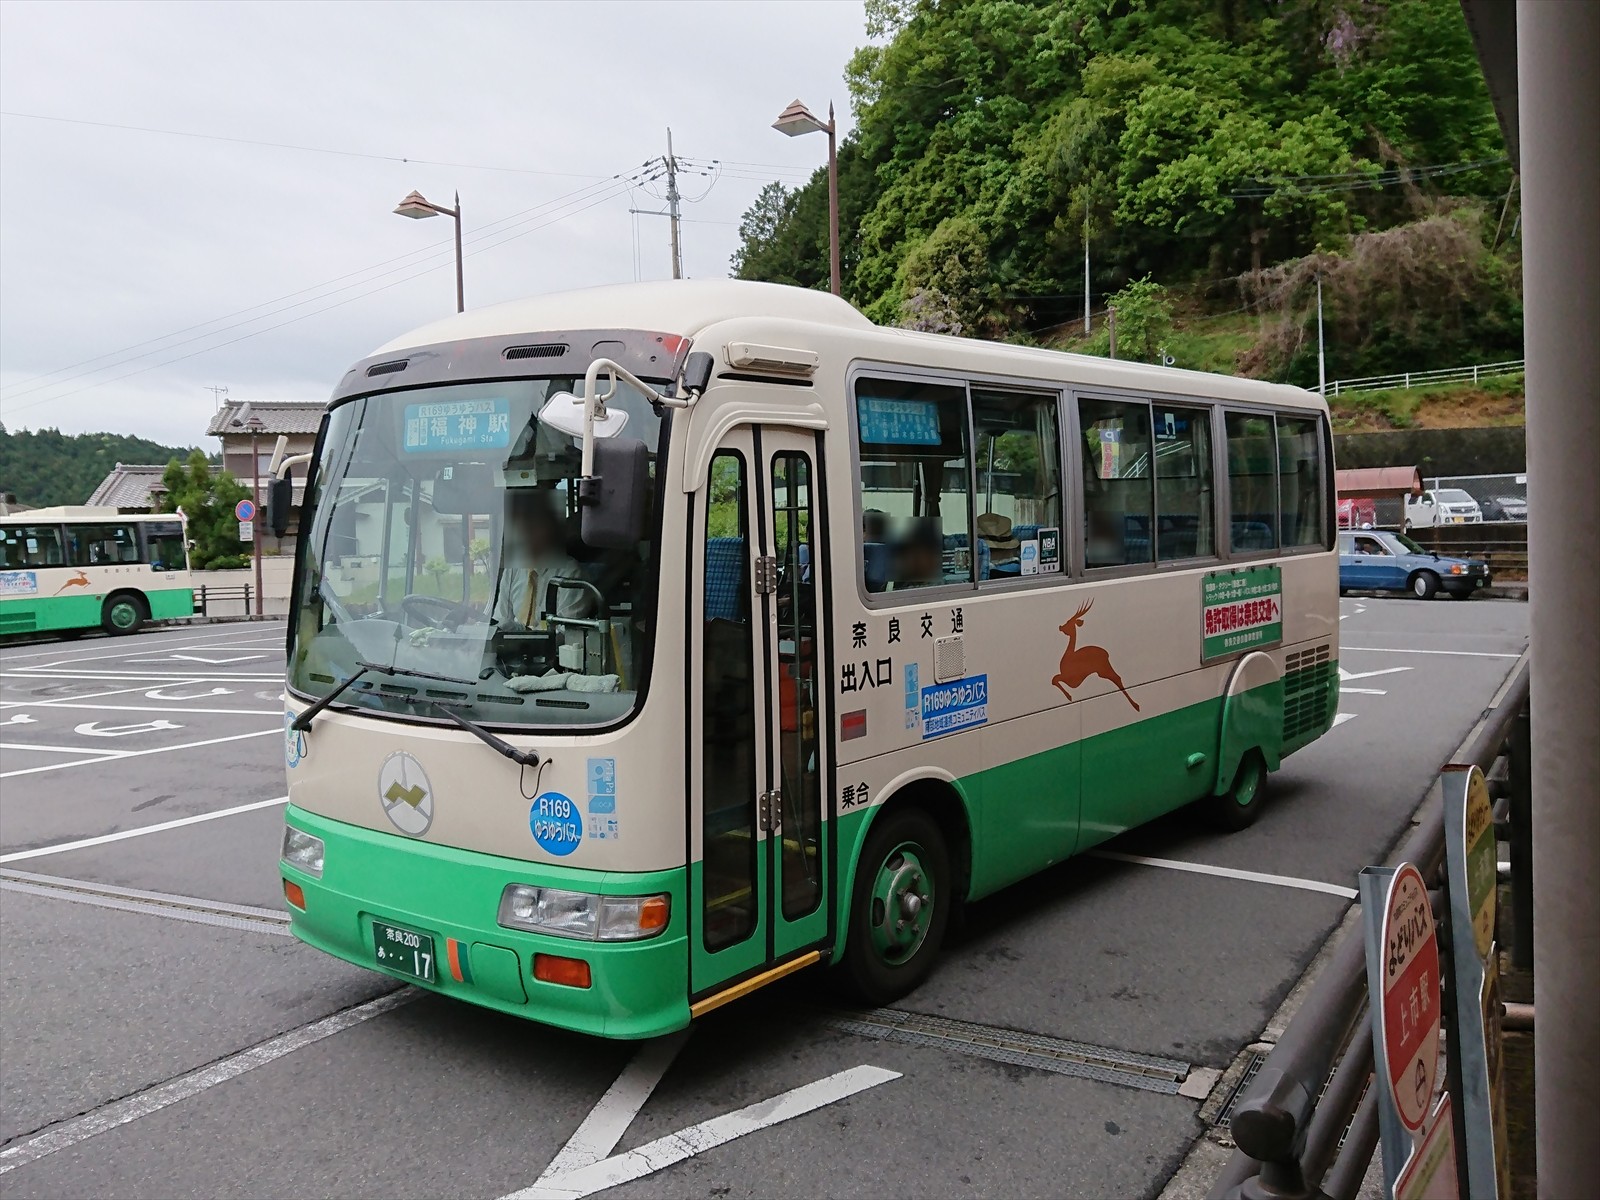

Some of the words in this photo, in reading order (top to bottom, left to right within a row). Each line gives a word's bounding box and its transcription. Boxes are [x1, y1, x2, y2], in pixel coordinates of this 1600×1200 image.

[430, 413, 508, 437] 福神駅
[852, 607, 964, 649] 奈良交通
[1205, 598, 1279, 635] 免許取得は奈良交通へ
[840, 656, 893, 695] 出入口
[924, 681, 987, 713] R169ゆうゆうバス
[540, 798, 570, 819] R169
[841, 781, 870, 810] 乗合
[534, 819, 578, 843] ゆうゆうバス
[377, 945, 386, 960] あ
[386, 927, 420, 949] 奈良200
[1399, 969, 1431, 1047] 上市駅
